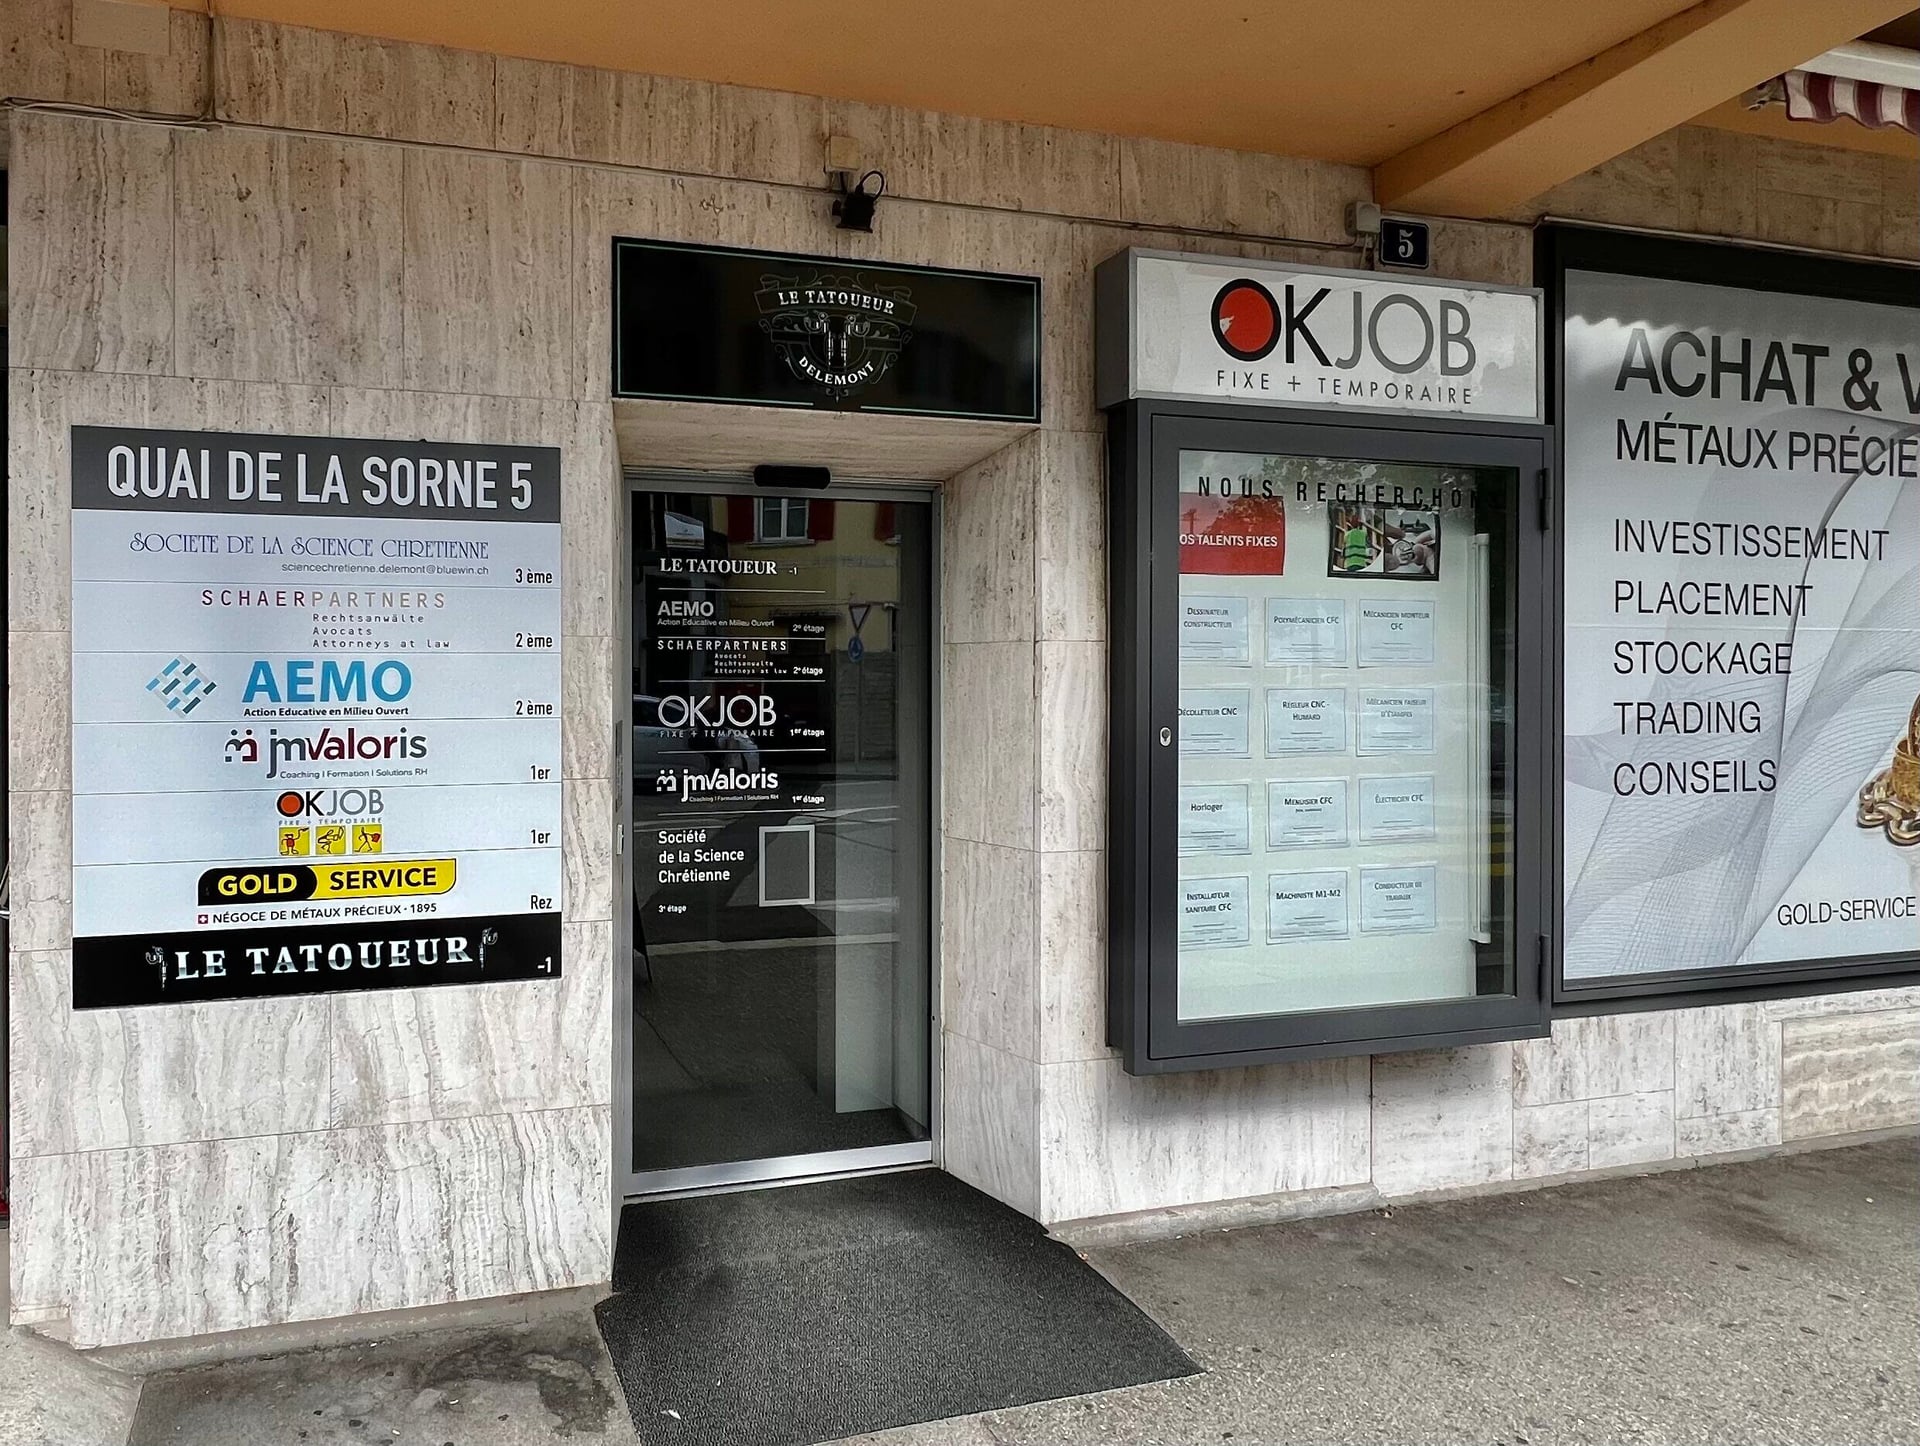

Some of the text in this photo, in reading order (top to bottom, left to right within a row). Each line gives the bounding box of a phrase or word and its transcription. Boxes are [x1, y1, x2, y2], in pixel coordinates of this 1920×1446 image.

[1399, 230, 1414, 258] 5
[778, 289, 894, 315] LE TATOUEUR
[799, 355, 875, 386] DELEMONT
[1614, 327, 1829, 407] ACHAT
[1843, 348, 1882, 411] &
[1217, 370, 1472, 405] FIXE + TEMPORAIRE
[1616, 412, 1778, 470] MÉTAUX
[107, 445, 533, 510] QUAI DE LA SORNE 5
[1199, 476, 1273, 499] NOUS
[130, 532, 490, 560] SOCIETE DE LA SCIENCE CHRETIENNE
[1197, 535, 1244, 546] TALENTS
[1246, 536, 1278, 547] FIXES
[1615, 518, 1889, 561] INVESTISSEMENT
[281, 561, 489, 576] sciencechretienne.delemont@bluewin.ch
[660, 558, 683, 573] LE
[686, 558, 778, 576] TATOUEUR
[515, 568, 553, 584] 3 ème
[1615, 580, 1813, 617] PLACEMENT
[657, 601, 714, 617] AEMO
[312, 612, 425, 623] Rechtsanwälte
[657, 618, 681, 626] Action
[1326, 616, 1339, 624] CFC
[312, 626, 373, 636] Avocats
[803, 624, 825, 634] étage
[312, 638, 450, 649] Attorneys at law
[515, 633, 553, 649] 2 ème
[657, 640, 787, 651] SCHAERPARTNERS
[1614, 640, 1792, 675] STOCKAGE
[801, 666, 823, 676] étage
[241, 659, 412, 703] AEMO
[244, 706, 409, 718] Action Educative en Milieu Ouvert
[515, 699, 553, 716] 2 ème
[657, 695, 777, 728] OKJOB
[1221, 707, 1237, 716] CNC
[1310, 700, 1326, 709] CNC
[1614, 700, 1761, 735] TRADING
[660, 730, 684, 738] FIXE
[704, 729, 775, 738] TEMPORAIRE
[802, 728, 825, 738] étage
[280, 770, 320, 780] Coaching
[326, 769, 369, 778] Formation
[376, 768, 413, 777] Solutions
[415, 768, 428, 776] RH
[530, 765, 551, 782] 1er
[1614, 759, 1777, 797] CONSEILS
[276, 789, 384, 818] OKJOB
[803, 795, 825, 805] étage
[1319, 796, 1333, 805] CFC
[1411, 794, 1424, 802] CFC
[1191, 803, 1223, 812] Horloger
[318, 817, 382, 825] TEMPORAIRE
[530, 829, 551, 845] 1er
[658, 829, 707, 845] Société
[659, 849, 745, 864] de la Science
[217, 867, 437, 897] GOLD SERVICE
[658, 869, 731, 884] Chrétienne
[1315, 889, 1341, 898] M1-M2
[530, 894, 552, 910] Rez
[667, 904, 687, 914] étage
[1218, 903, 1232, 912] CFC
[212, 910, 266, 924] NÉGOCE
[269, 909, 288, 921] DE
[291, 905, 341, 920] MÉTAUX
[344, 903, 401, 917] PRÉCIEUX
[410, 902, 437, 914] 1895
[1777, 896, 1916, 926] GOLD-SERVICE
[175, 935, 474, 981] LE TATOUEUR
[536, 957, 552, 973] -1
